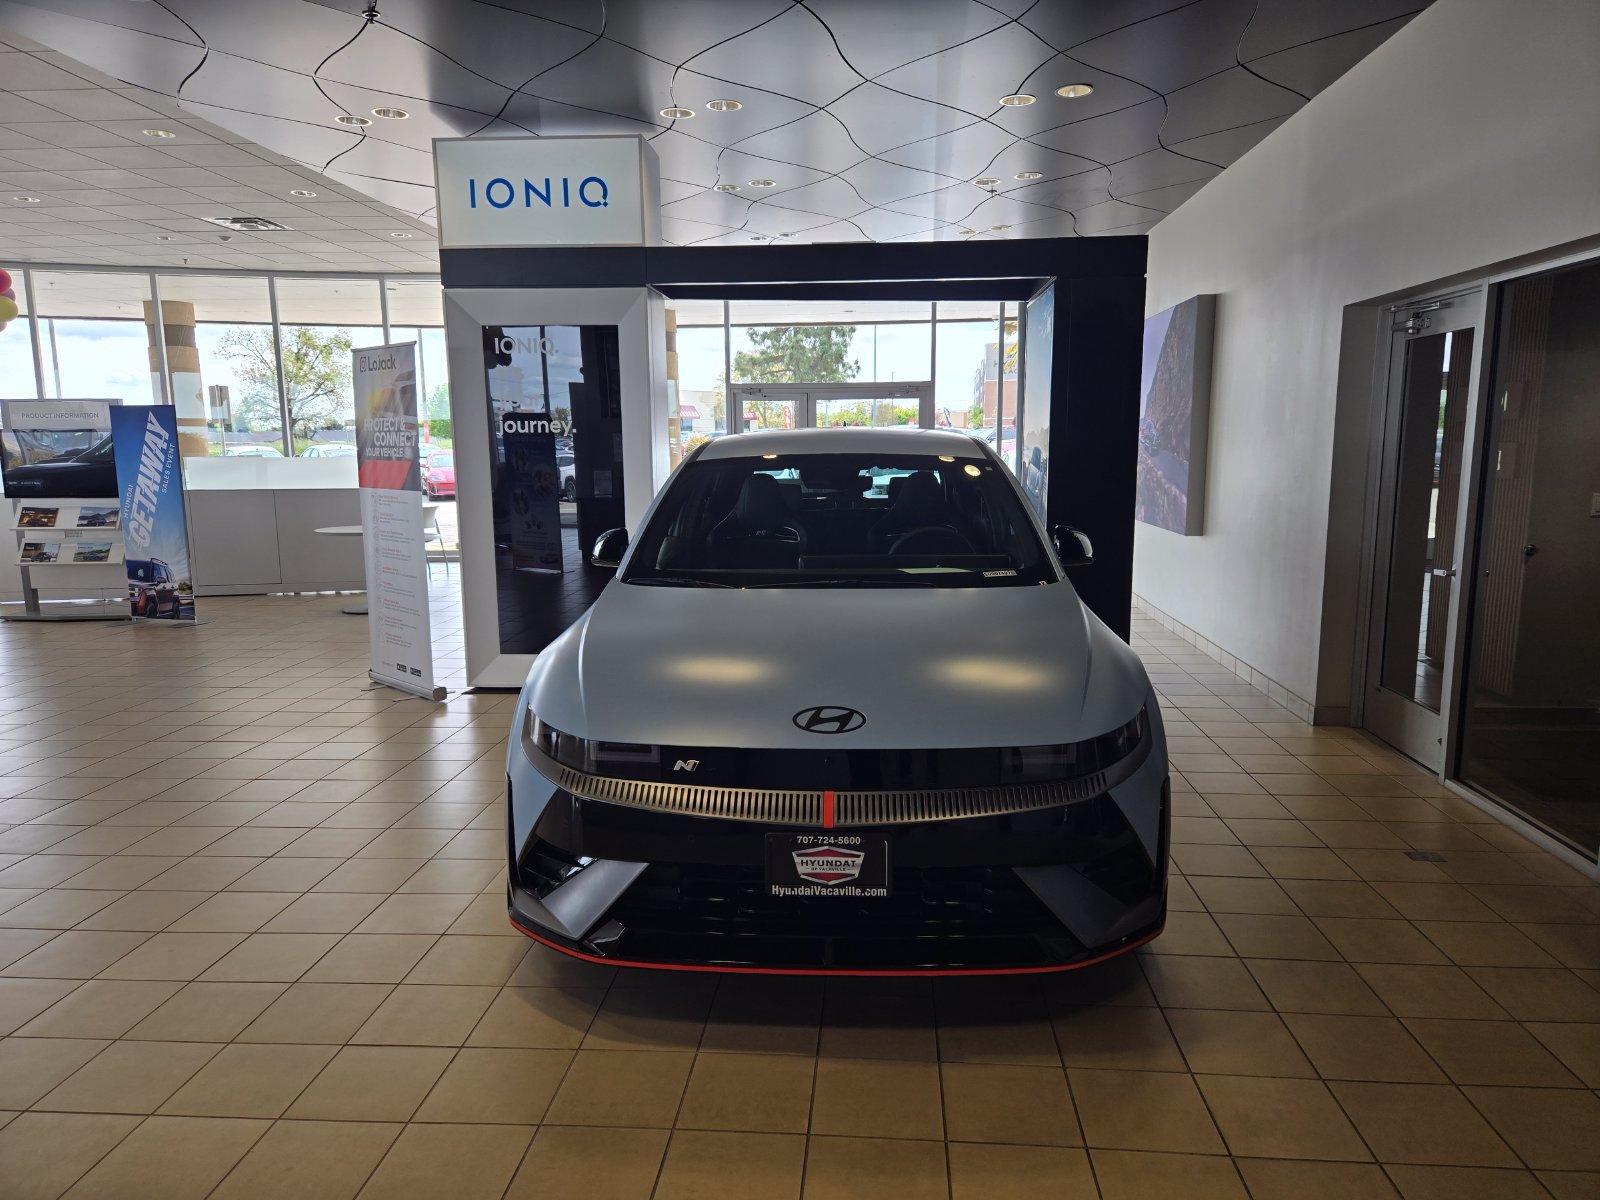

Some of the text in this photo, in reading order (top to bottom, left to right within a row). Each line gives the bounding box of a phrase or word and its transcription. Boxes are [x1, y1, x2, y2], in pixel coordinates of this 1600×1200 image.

[469, 176, 609, 209] IONIQ
[364, 416, 405, 431] PROTECT &
[499, 416, 577, 437] journey.
[374, 431, 417, 447] CONNECT
[365, 447, 404, 457] YOUR VEHICLE
[161, 443, 176, 493] SALES EVENT
[128, 411, 169, 550] GETAWAY
[124, 484, 134, 519] HYUNDAI
[797, 836, 861, 844] 707-724-5600
[800, 859, 857, 867] HYUNDAI
[771, 885, 887, 897] HyundaiVacaville.com
